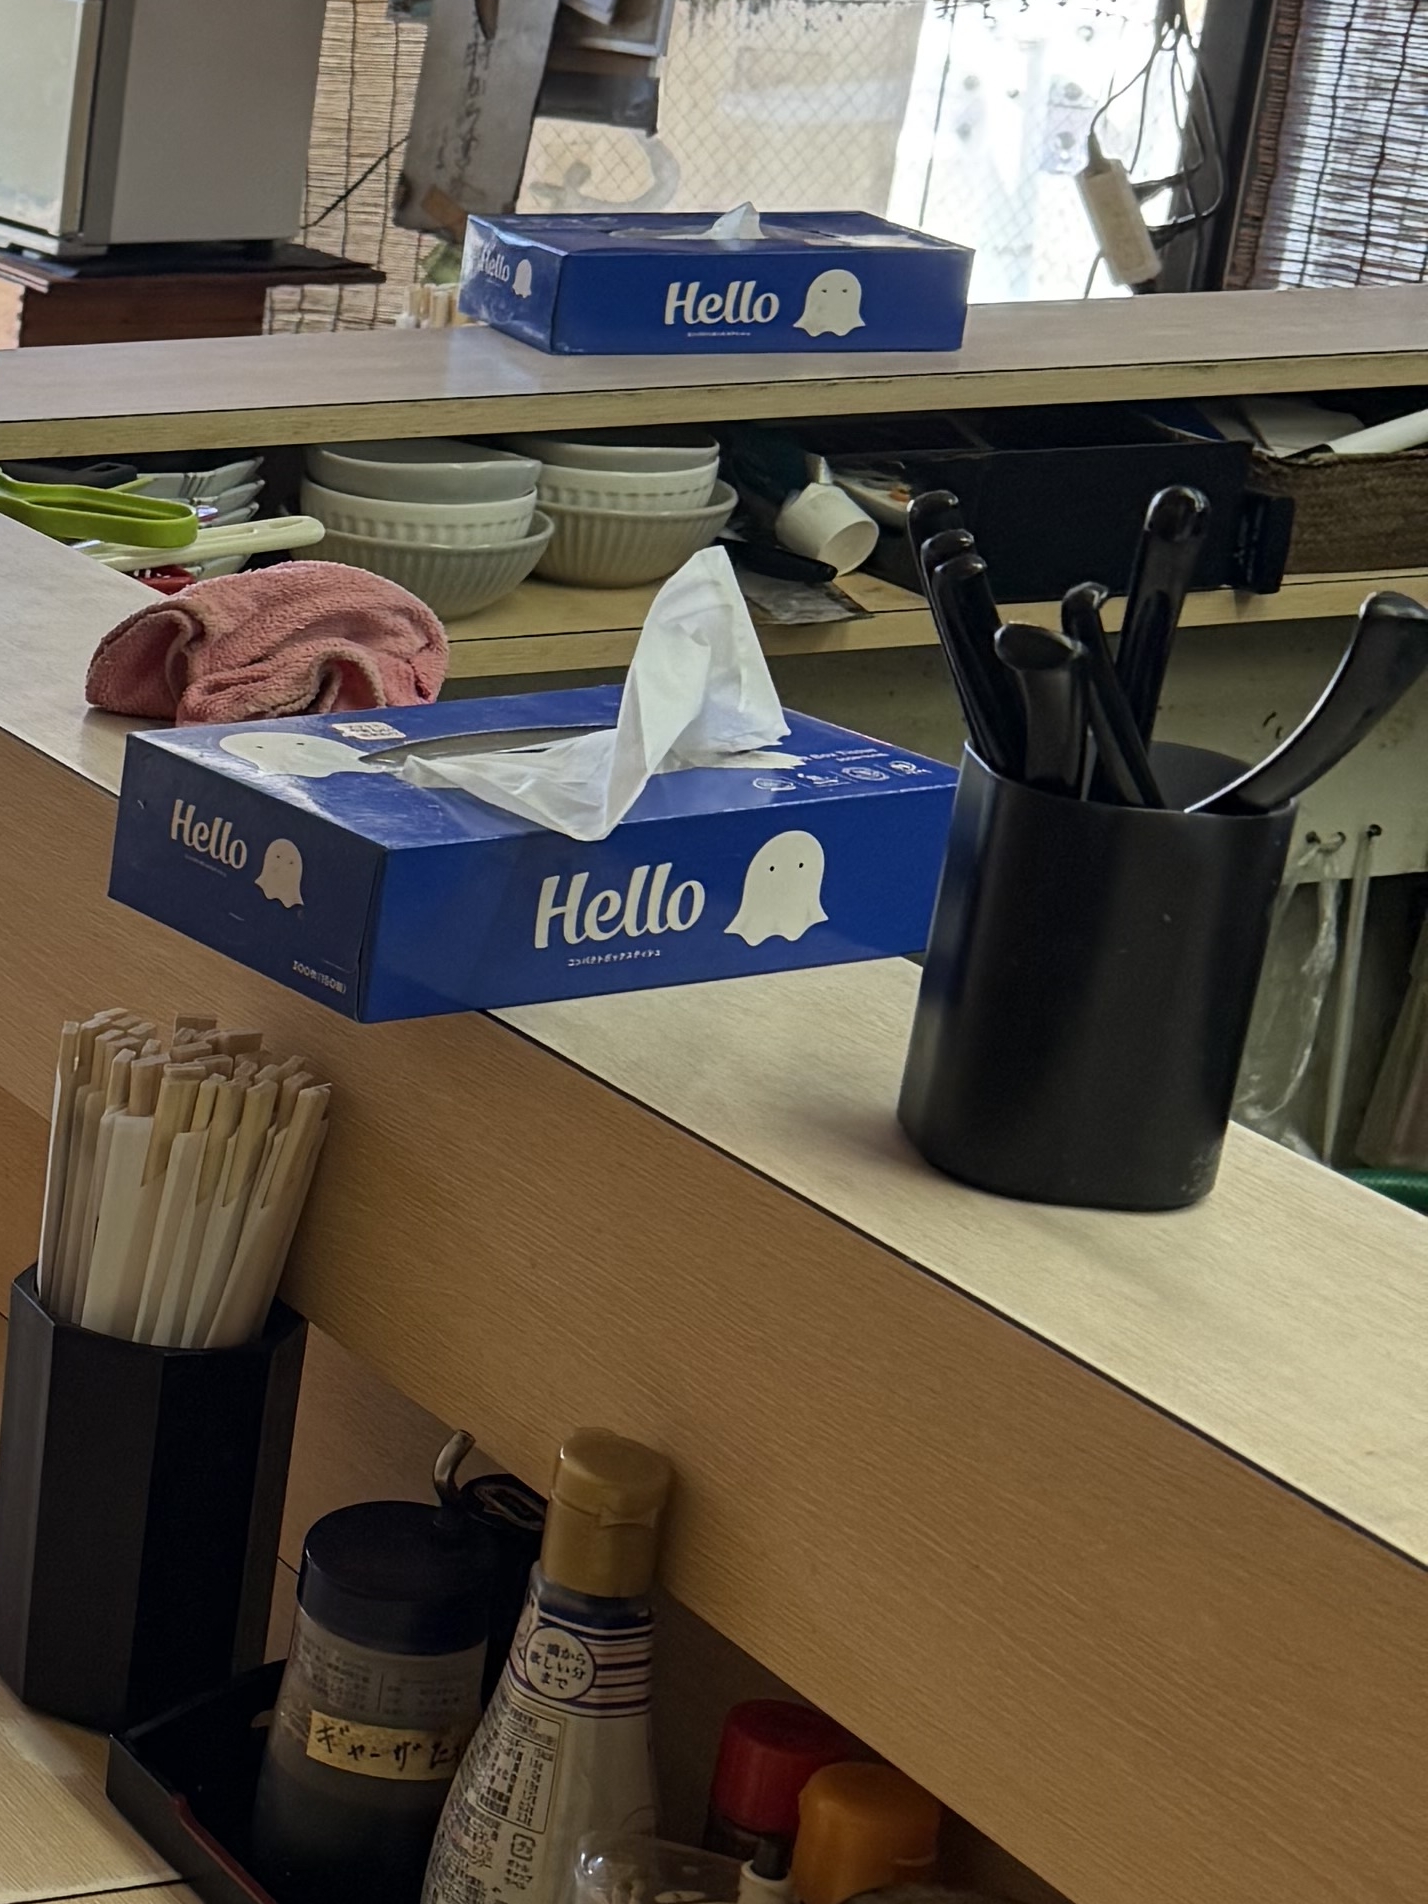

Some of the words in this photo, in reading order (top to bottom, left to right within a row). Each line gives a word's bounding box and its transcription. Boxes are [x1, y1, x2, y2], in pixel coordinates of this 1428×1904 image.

[478, 241, 510, 284] Hello
[663, 280, 781, 326] Hello
[170, 797, 249, 872] Hello
[533, 861, 706, 949] Hello
[540, 1671, 569, 1690] まで
